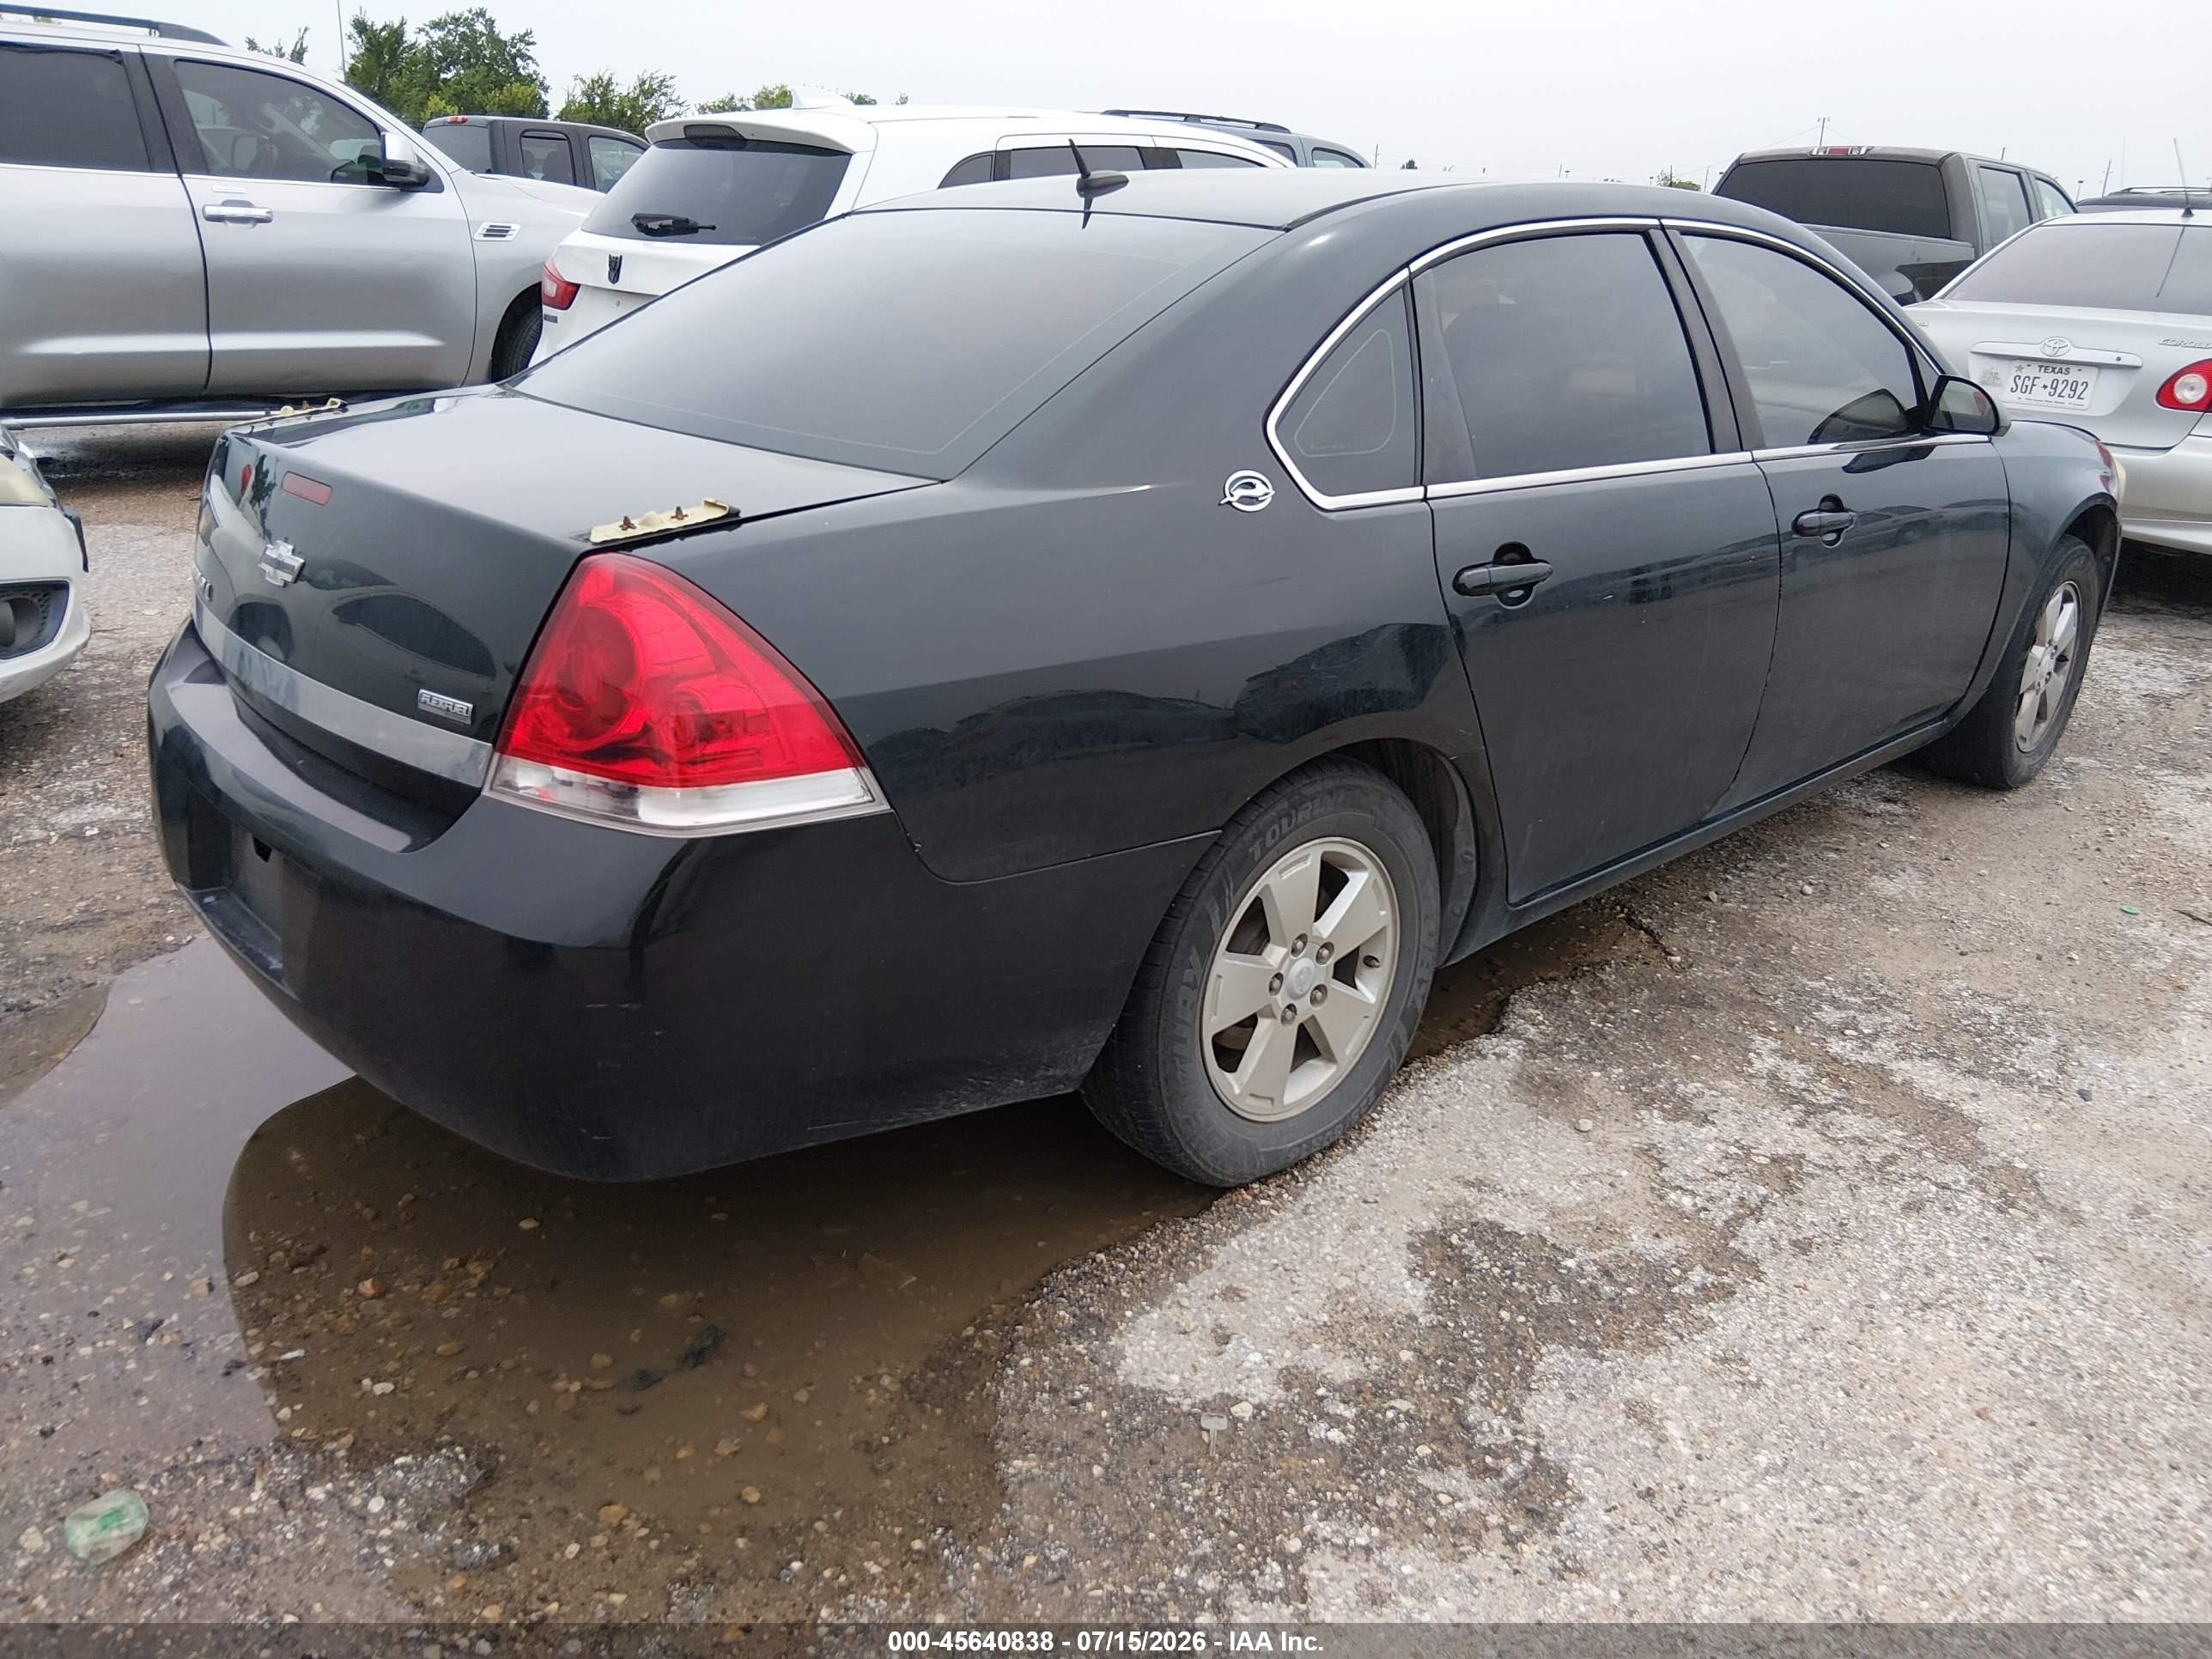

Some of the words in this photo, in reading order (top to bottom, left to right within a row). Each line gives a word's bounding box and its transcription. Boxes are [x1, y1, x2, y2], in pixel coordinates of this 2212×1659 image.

[2038, 365, 2070, 375] TEXAS
[2010, 374, 2040, 395] SGF
[2048, 378, 2088, 400] 9292
